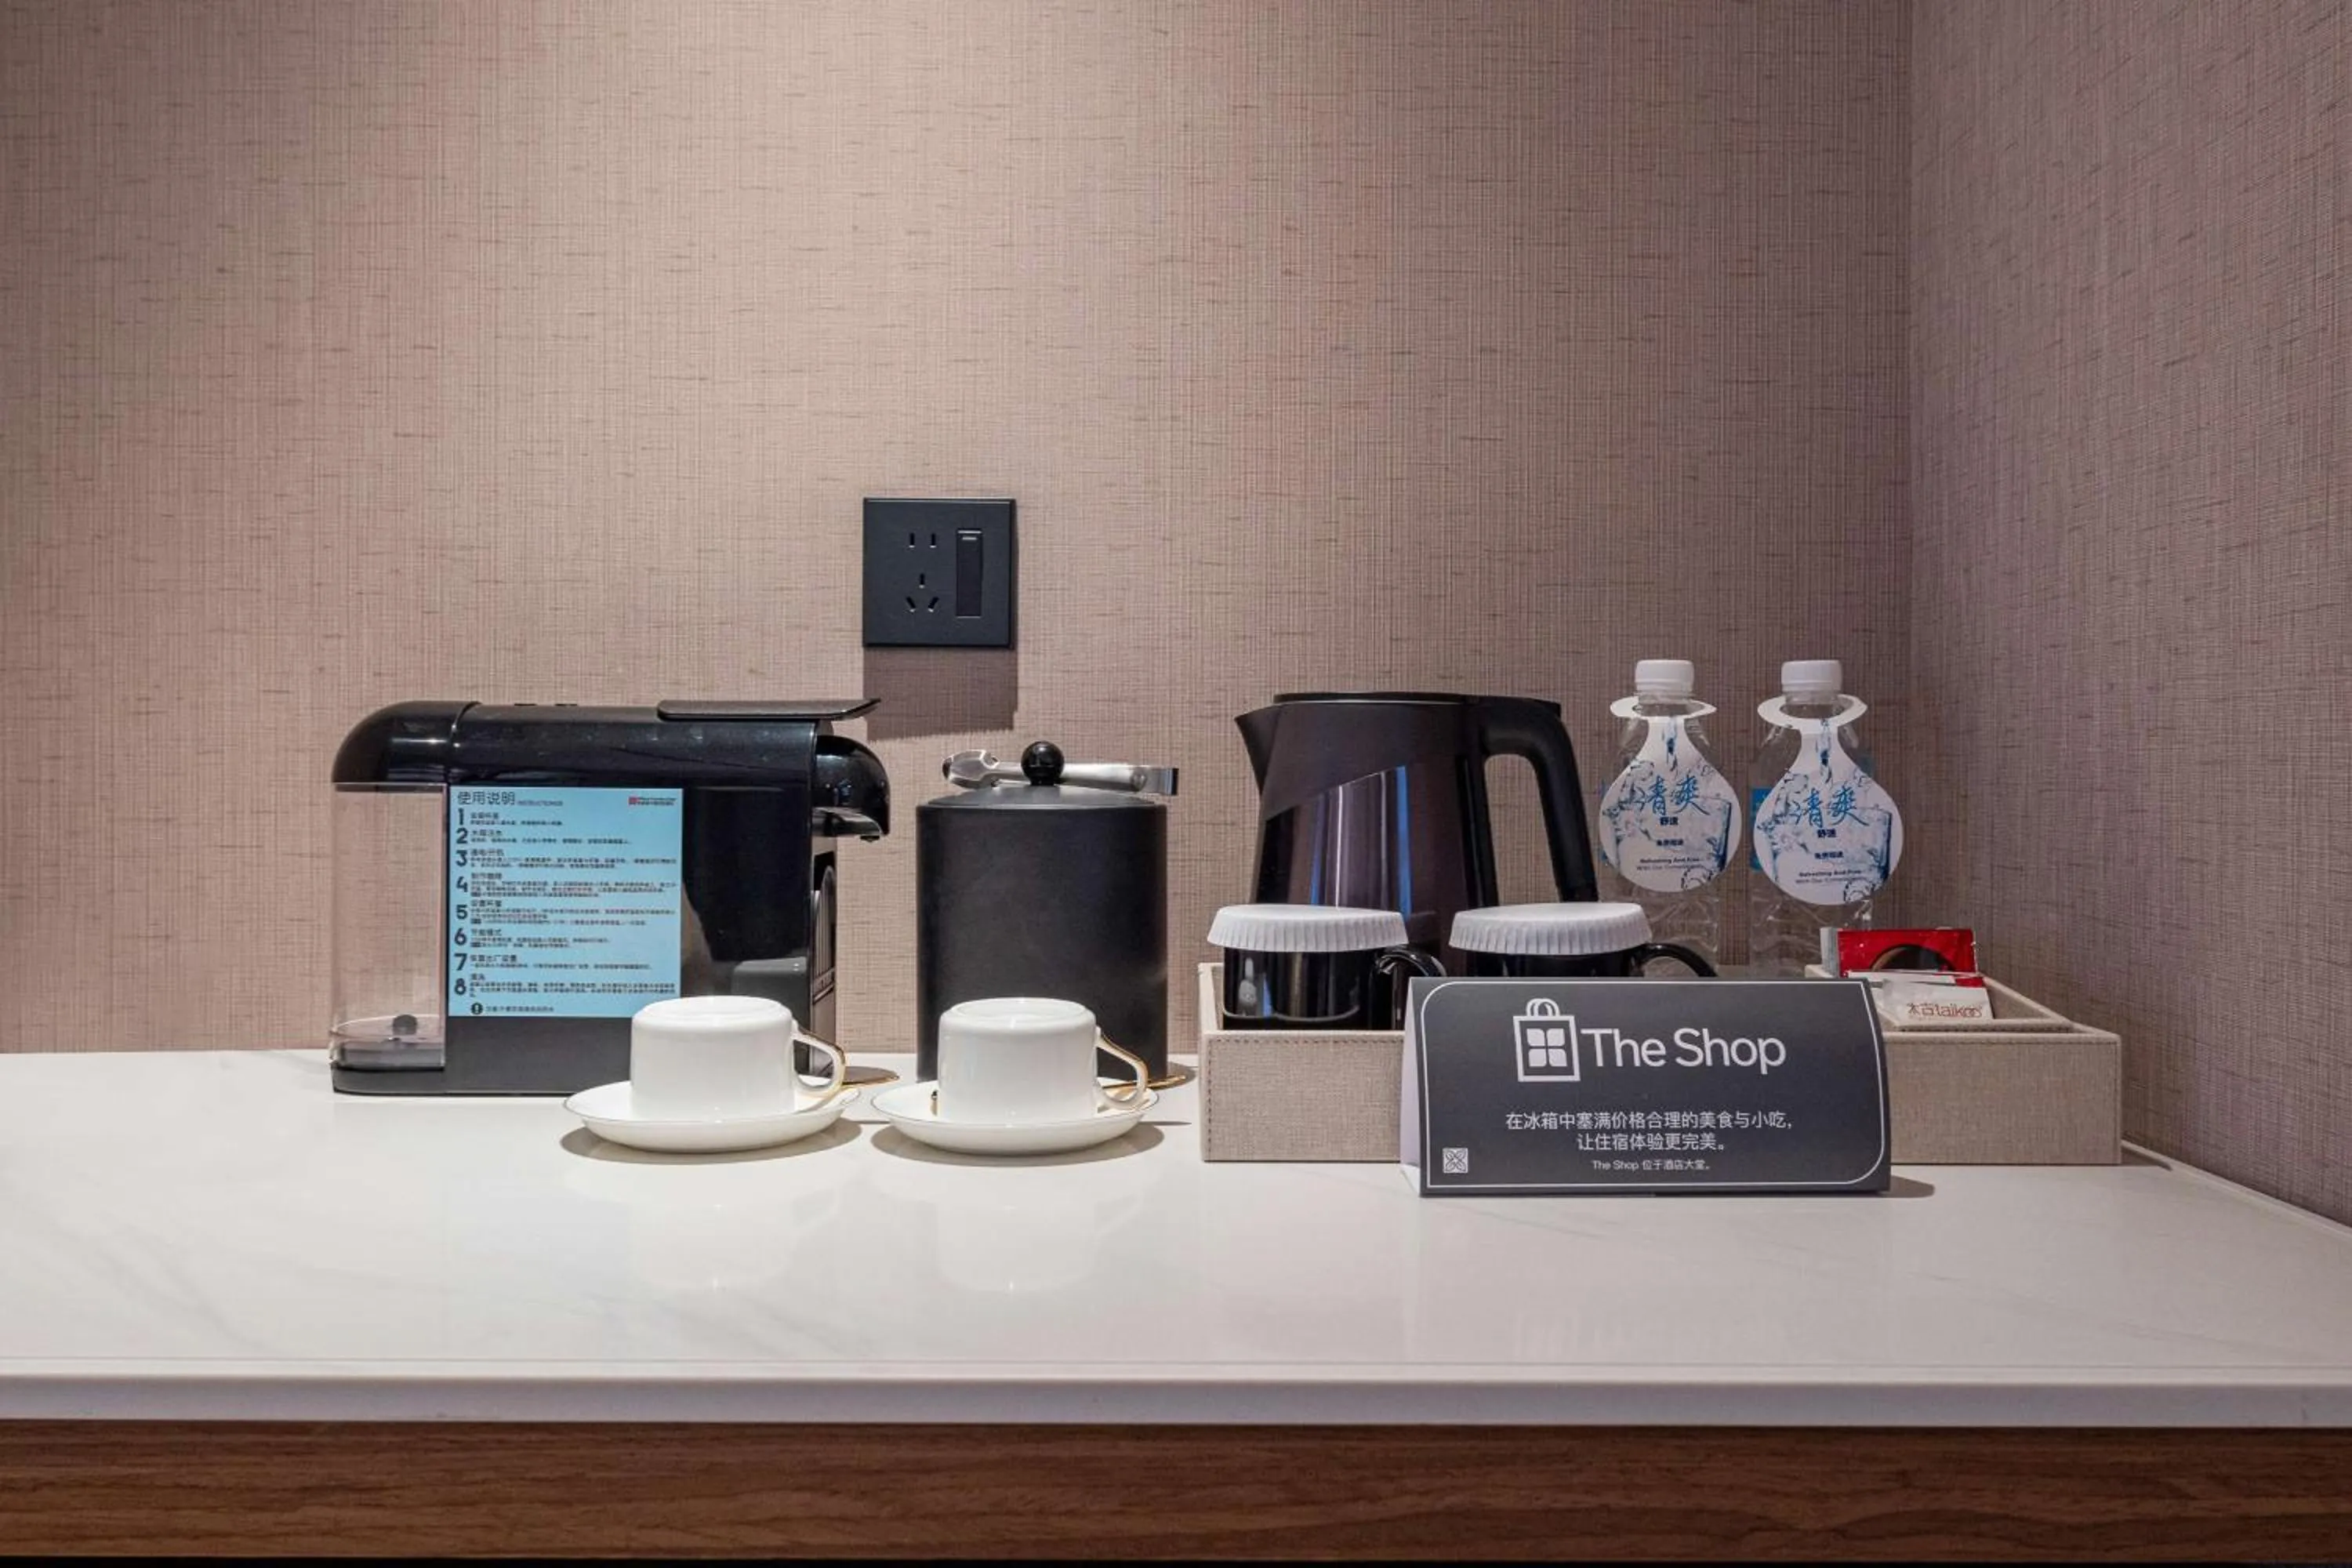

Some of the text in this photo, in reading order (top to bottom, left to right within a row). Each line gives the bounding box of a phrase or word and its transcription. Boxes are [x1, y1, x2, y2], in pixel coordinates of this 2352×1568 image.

[458, 792, 515, 805] 使用说明
[458, 808, 465, 826] 1
[456, 827, 469, 844] 2
[456, 850, 469, 867] 3
[456, 877, 468, 893] 4
[456, 905, 468, 920] 5
[455, 927, 467, 946] 6
[454, 953, 468, 971] 7
[454, 978, 466, 996] 8
[1581, 1028, 1786, 1074] The Shop
[1577, 1133, 1725, 1151] 让住宿体验更完美。
[1592, 1160, 1610, 1170] The
[1613, 1160, 1639, 1171] Shop
